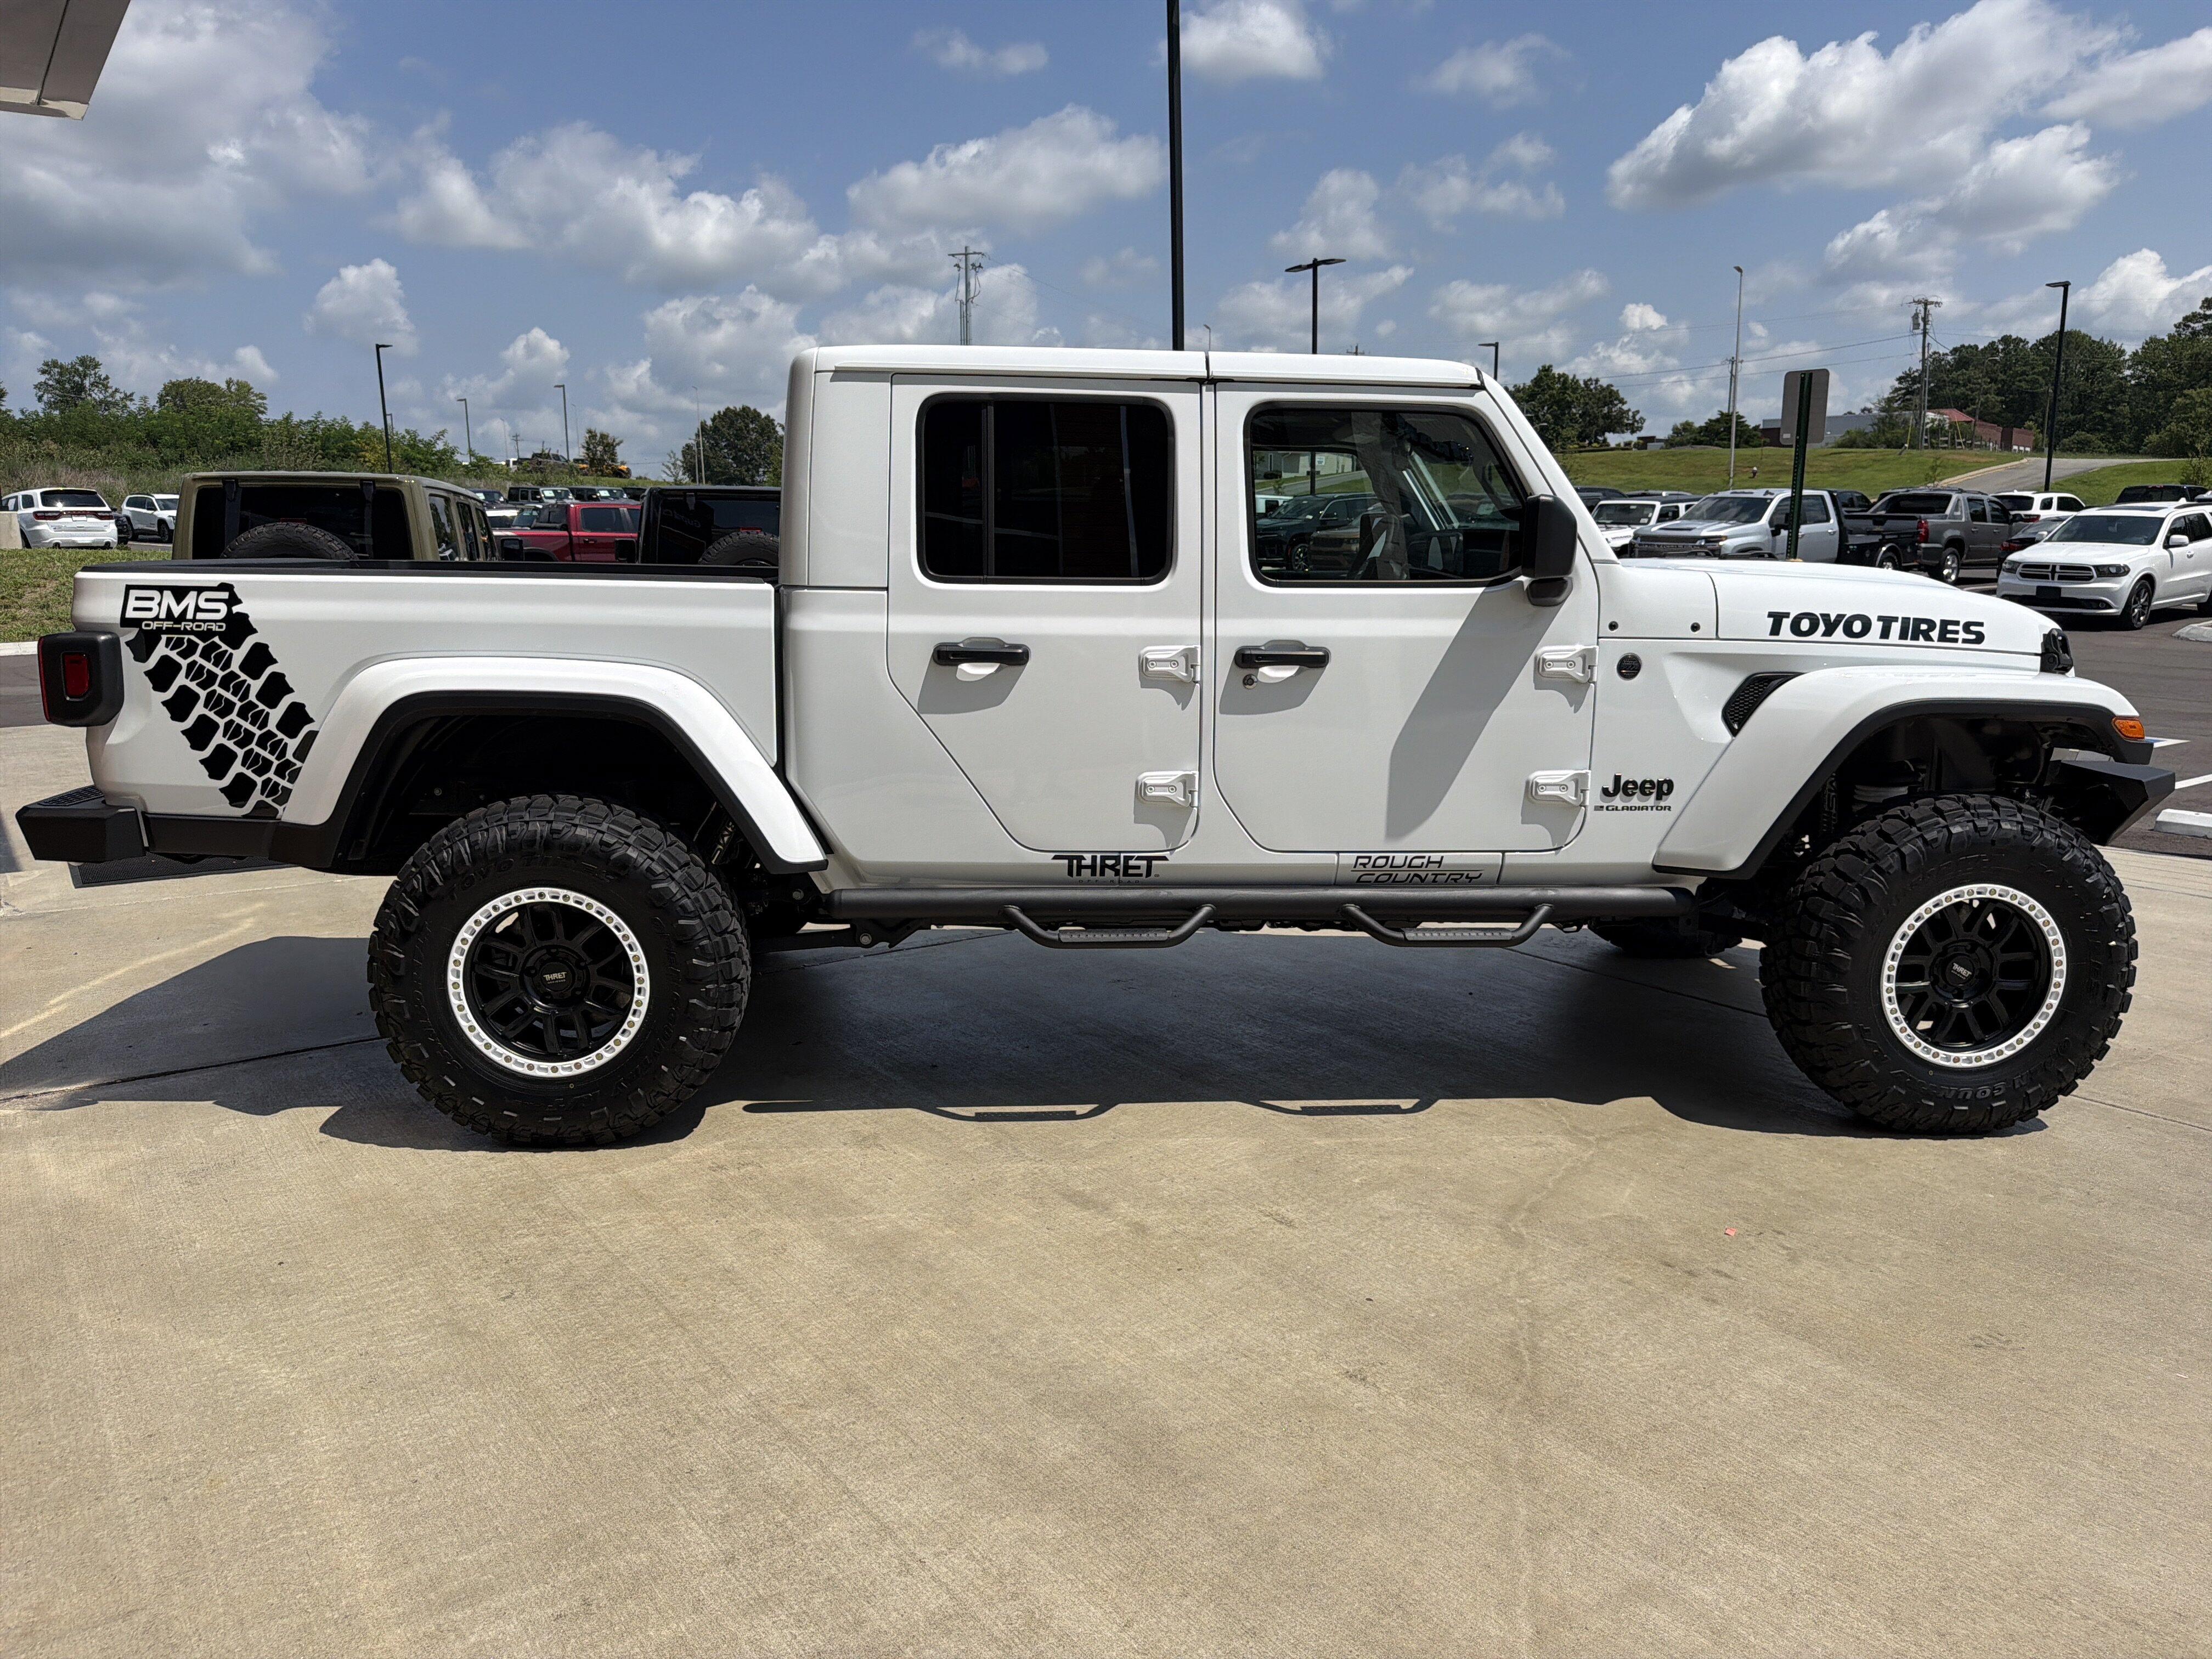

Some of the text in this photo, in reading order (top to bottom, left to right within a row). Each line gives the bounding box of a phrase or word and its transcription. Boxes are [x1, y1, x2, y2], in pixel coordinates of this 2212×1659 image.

[125, 589, 229, 620] BMS
[142, 620, 226, 631] OFF-ROAD
[1767, 611, 1985, 645] TOYO TIRES
[1601, 773, 1674, 801] Jeep
[1051, 854, 1170, 878] THRET
[1353, 855, 1444, 869] ROUGH
[1355, 873, 1483, 883] COUNTRY
[543, 972, 567, 981] THRET
[1953, 962, 1972, 978] THRET
